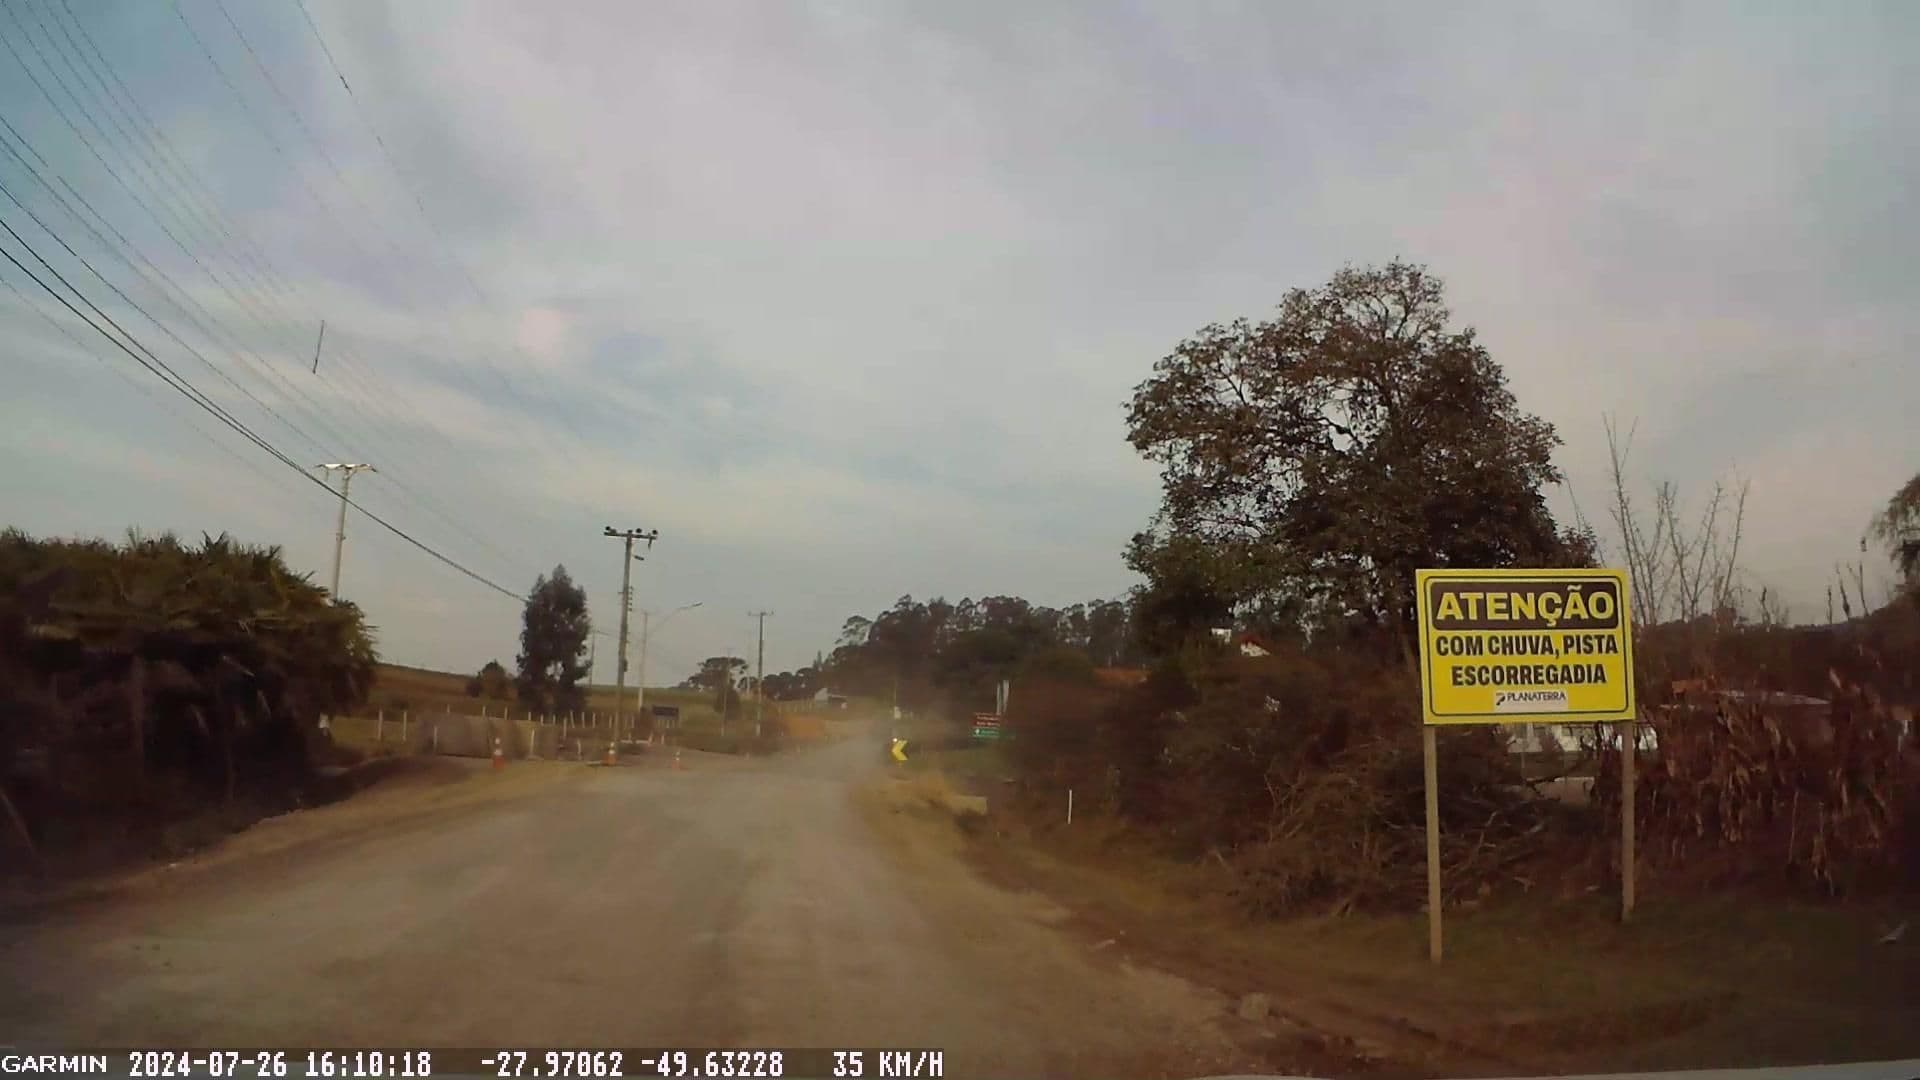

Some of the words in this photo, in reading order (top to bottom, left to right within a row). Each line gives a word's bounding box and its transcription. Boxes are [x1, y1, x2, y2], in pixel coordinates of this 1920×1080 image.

[1436, 584, 1615, 627] ATENÇÃO
[1436, 635, 1483, 656] COM
[1487, 634, 1559, 659] CHUVA,
[1563, 634, 1618, 655] PISTA
[1451, 664, 1606, 686] ESCORREGADIA
[1507, 691, 1567, 702] PLANATERRA
